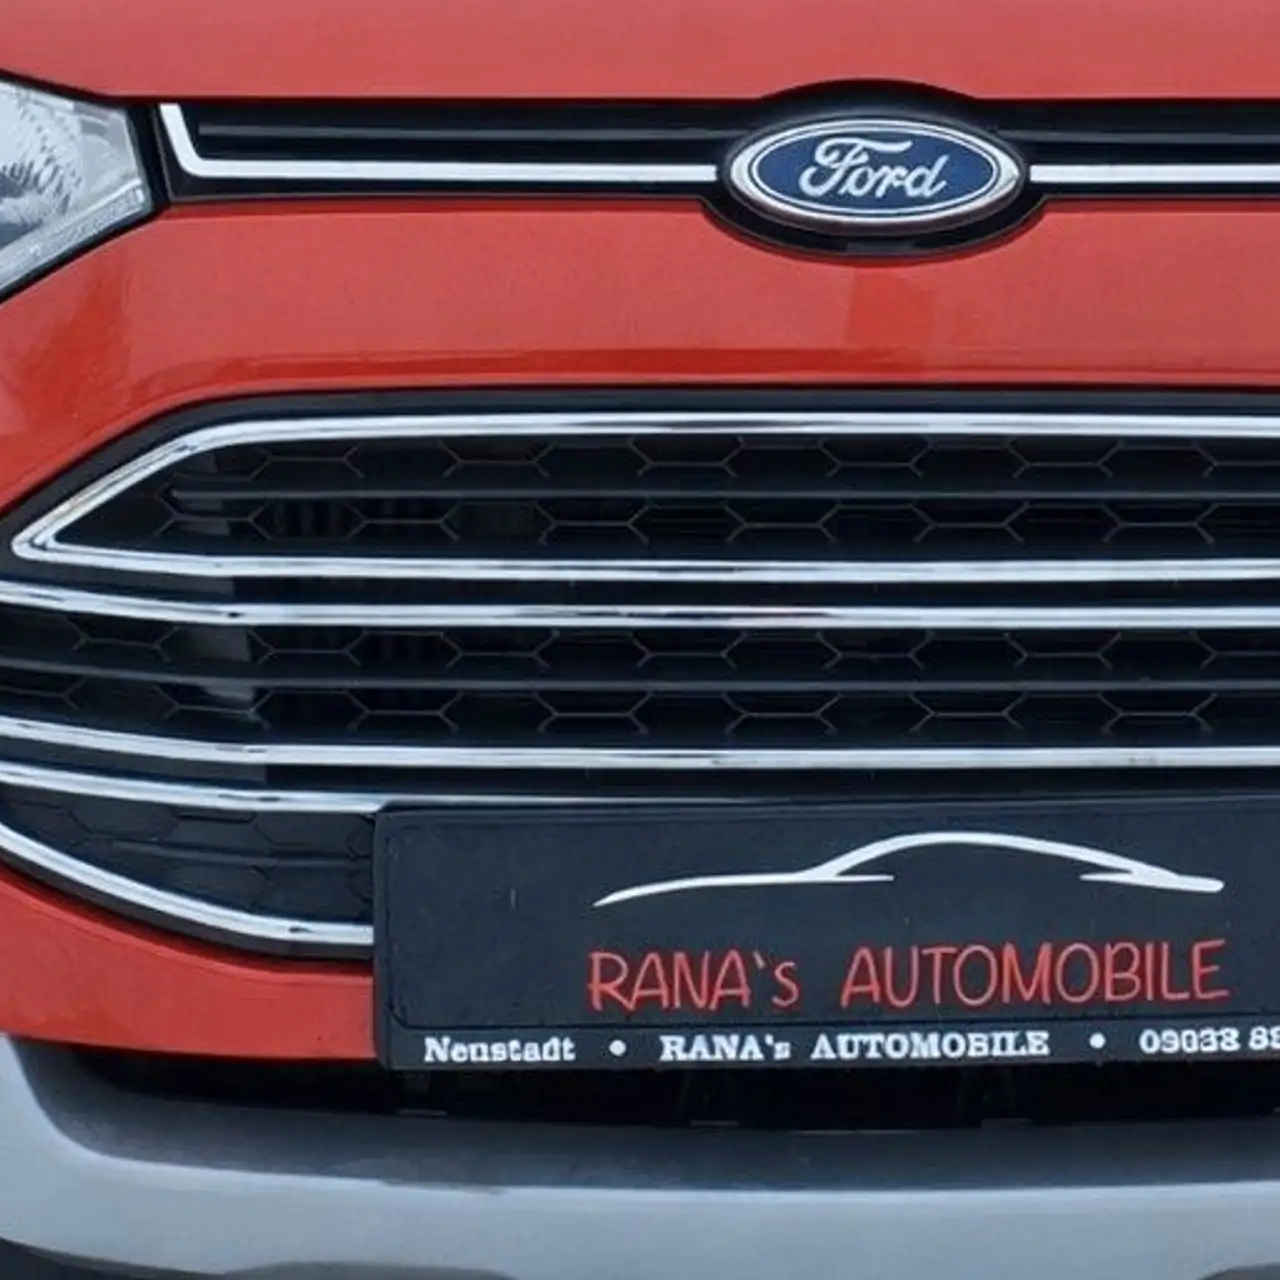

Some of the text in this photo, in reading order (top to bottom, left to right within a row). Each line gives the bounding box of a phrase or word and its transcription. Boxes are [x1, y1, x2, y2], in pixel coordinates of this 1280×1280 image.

[799, 137, 949, 197] Ford
[841, 940, 1228, 1008] AUTOMOBILE
[424, 1034, 575, 1062] Neustadt
[810, 1030, 1050, 1060] AUTOMOBILE
